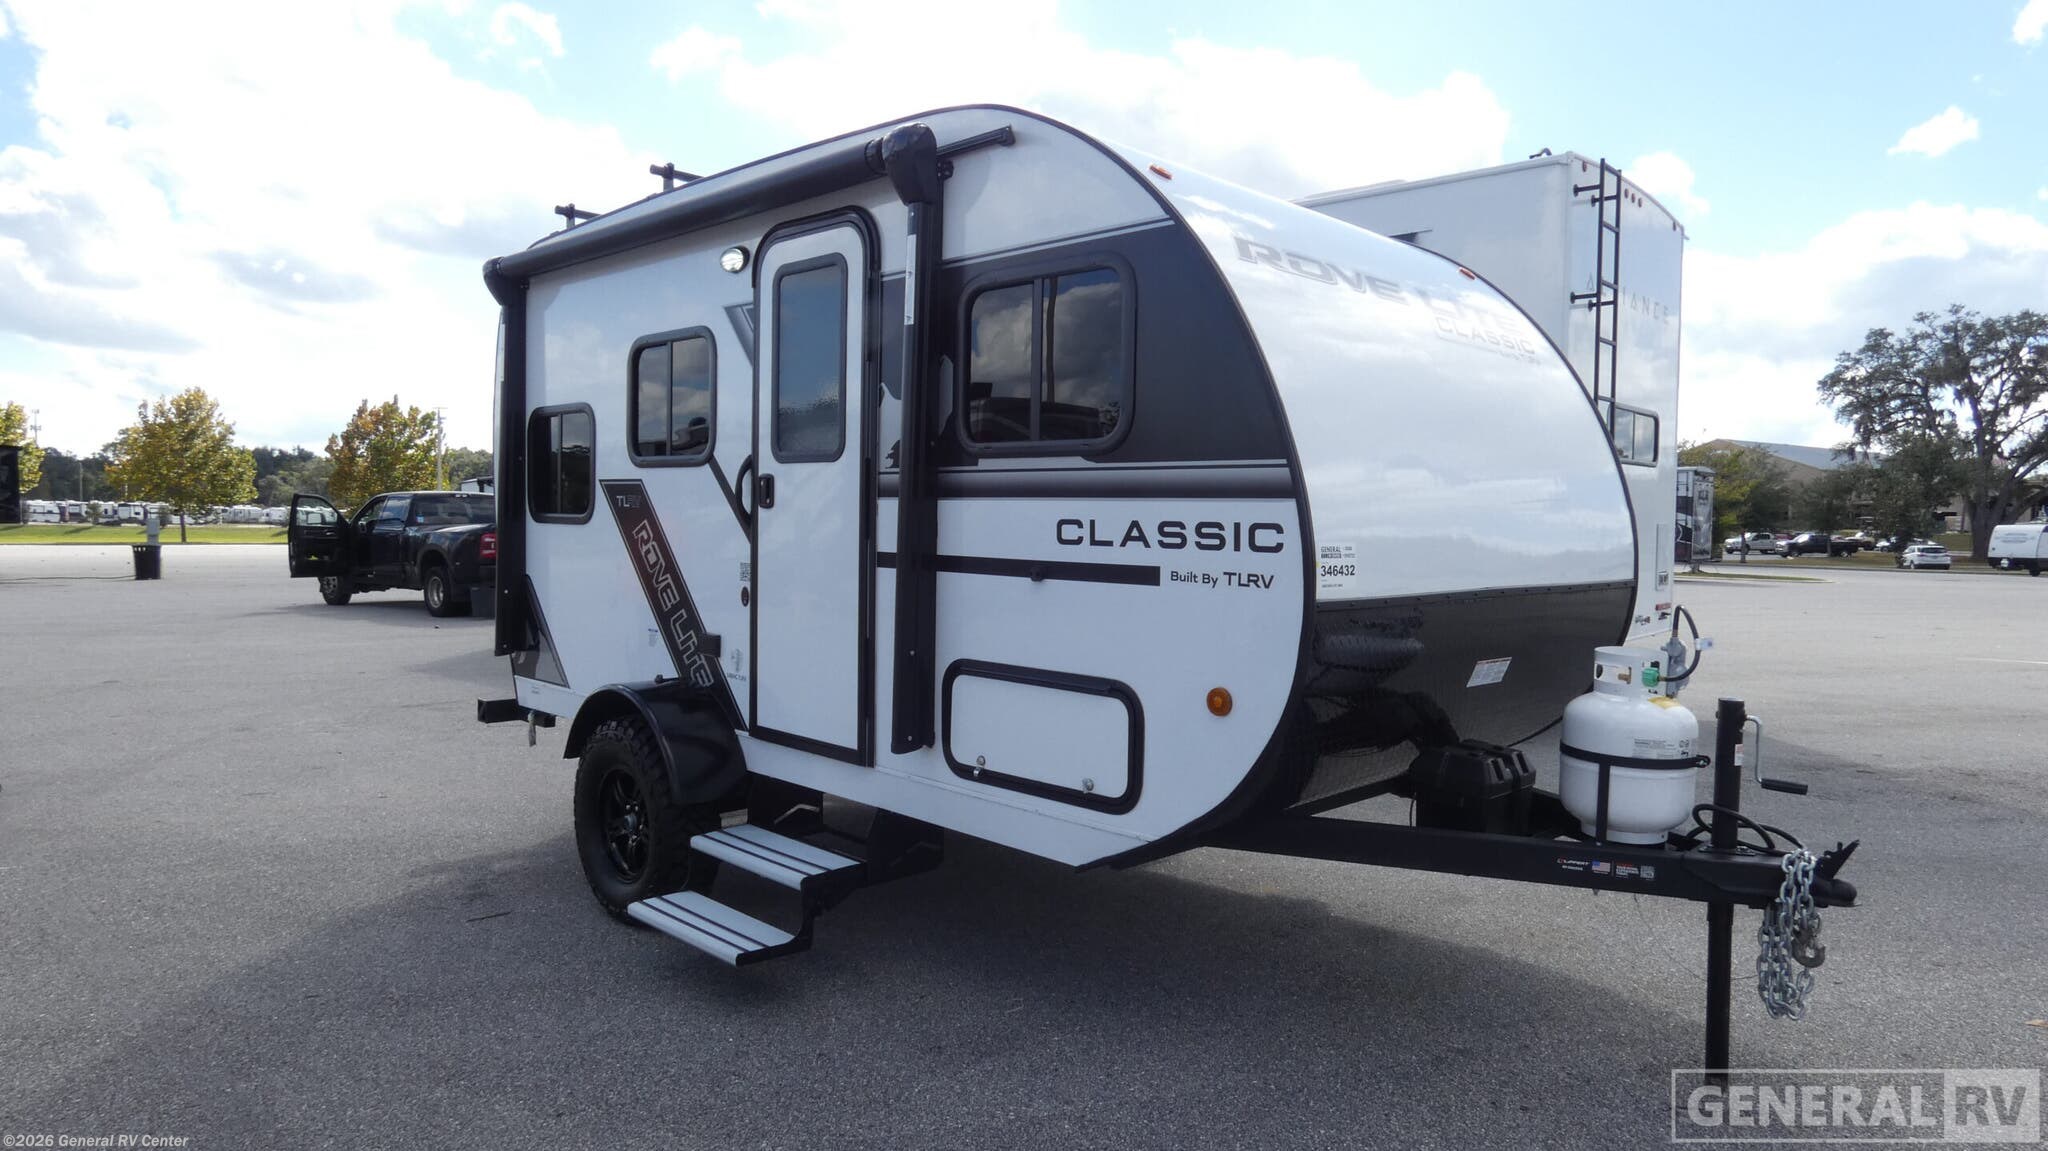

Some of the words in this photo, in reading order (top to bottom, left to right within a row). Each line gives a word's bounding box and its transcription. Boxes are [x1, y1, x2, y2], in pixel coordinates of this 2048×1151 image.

[1234, 236, 1410, 306] ROVE
[1435, 316, 1536, 355] CLASSIC
[1056, 518, 1285, 553] CLASSIC
[632, 519, 681, 612] ROVE
[1170, 571, 1199, 584] Built
[1202, 573, 1219, 589] By
[1223, 571, 1275, 589] TLRV
[1320, 564, 1356, 577] 346432
